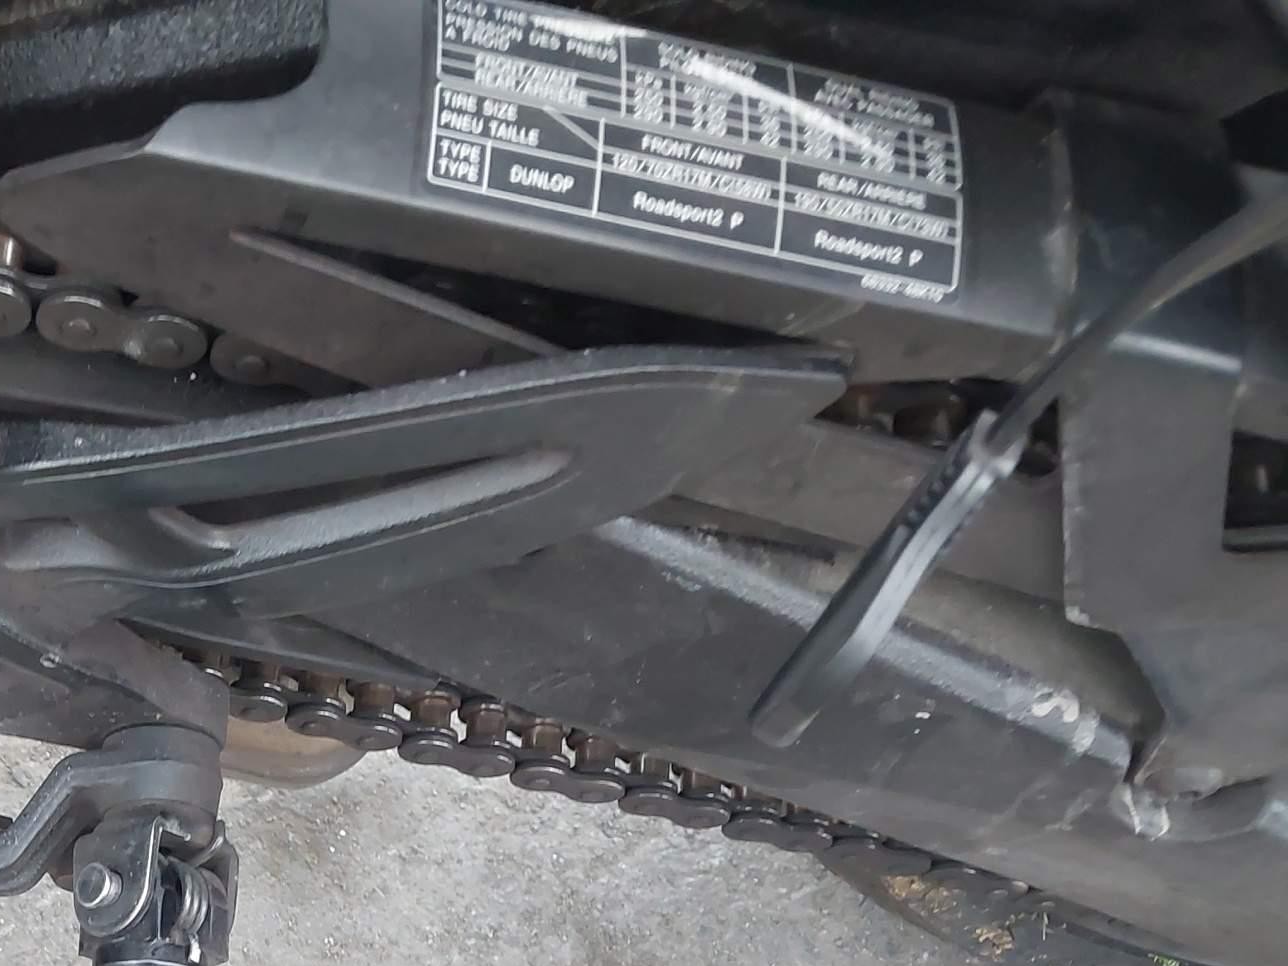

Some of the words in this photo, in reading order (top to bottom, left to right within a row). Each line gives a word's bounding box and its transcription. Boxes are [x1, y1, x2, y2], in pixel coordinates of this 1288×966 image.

[441, 89, 478, 112] TIRE
[482, 99, 518, 121] SIZE
[439, 110, 485, 134] PNEU
[488, 120, 539, 146] TAILLE
[439, 139, 481, 163] TYPE
[437, 157, 480, 182] TYPE
[509, 163, 575, 195] DUNLOP
[632, 190, 724, 229] Roadsport2
